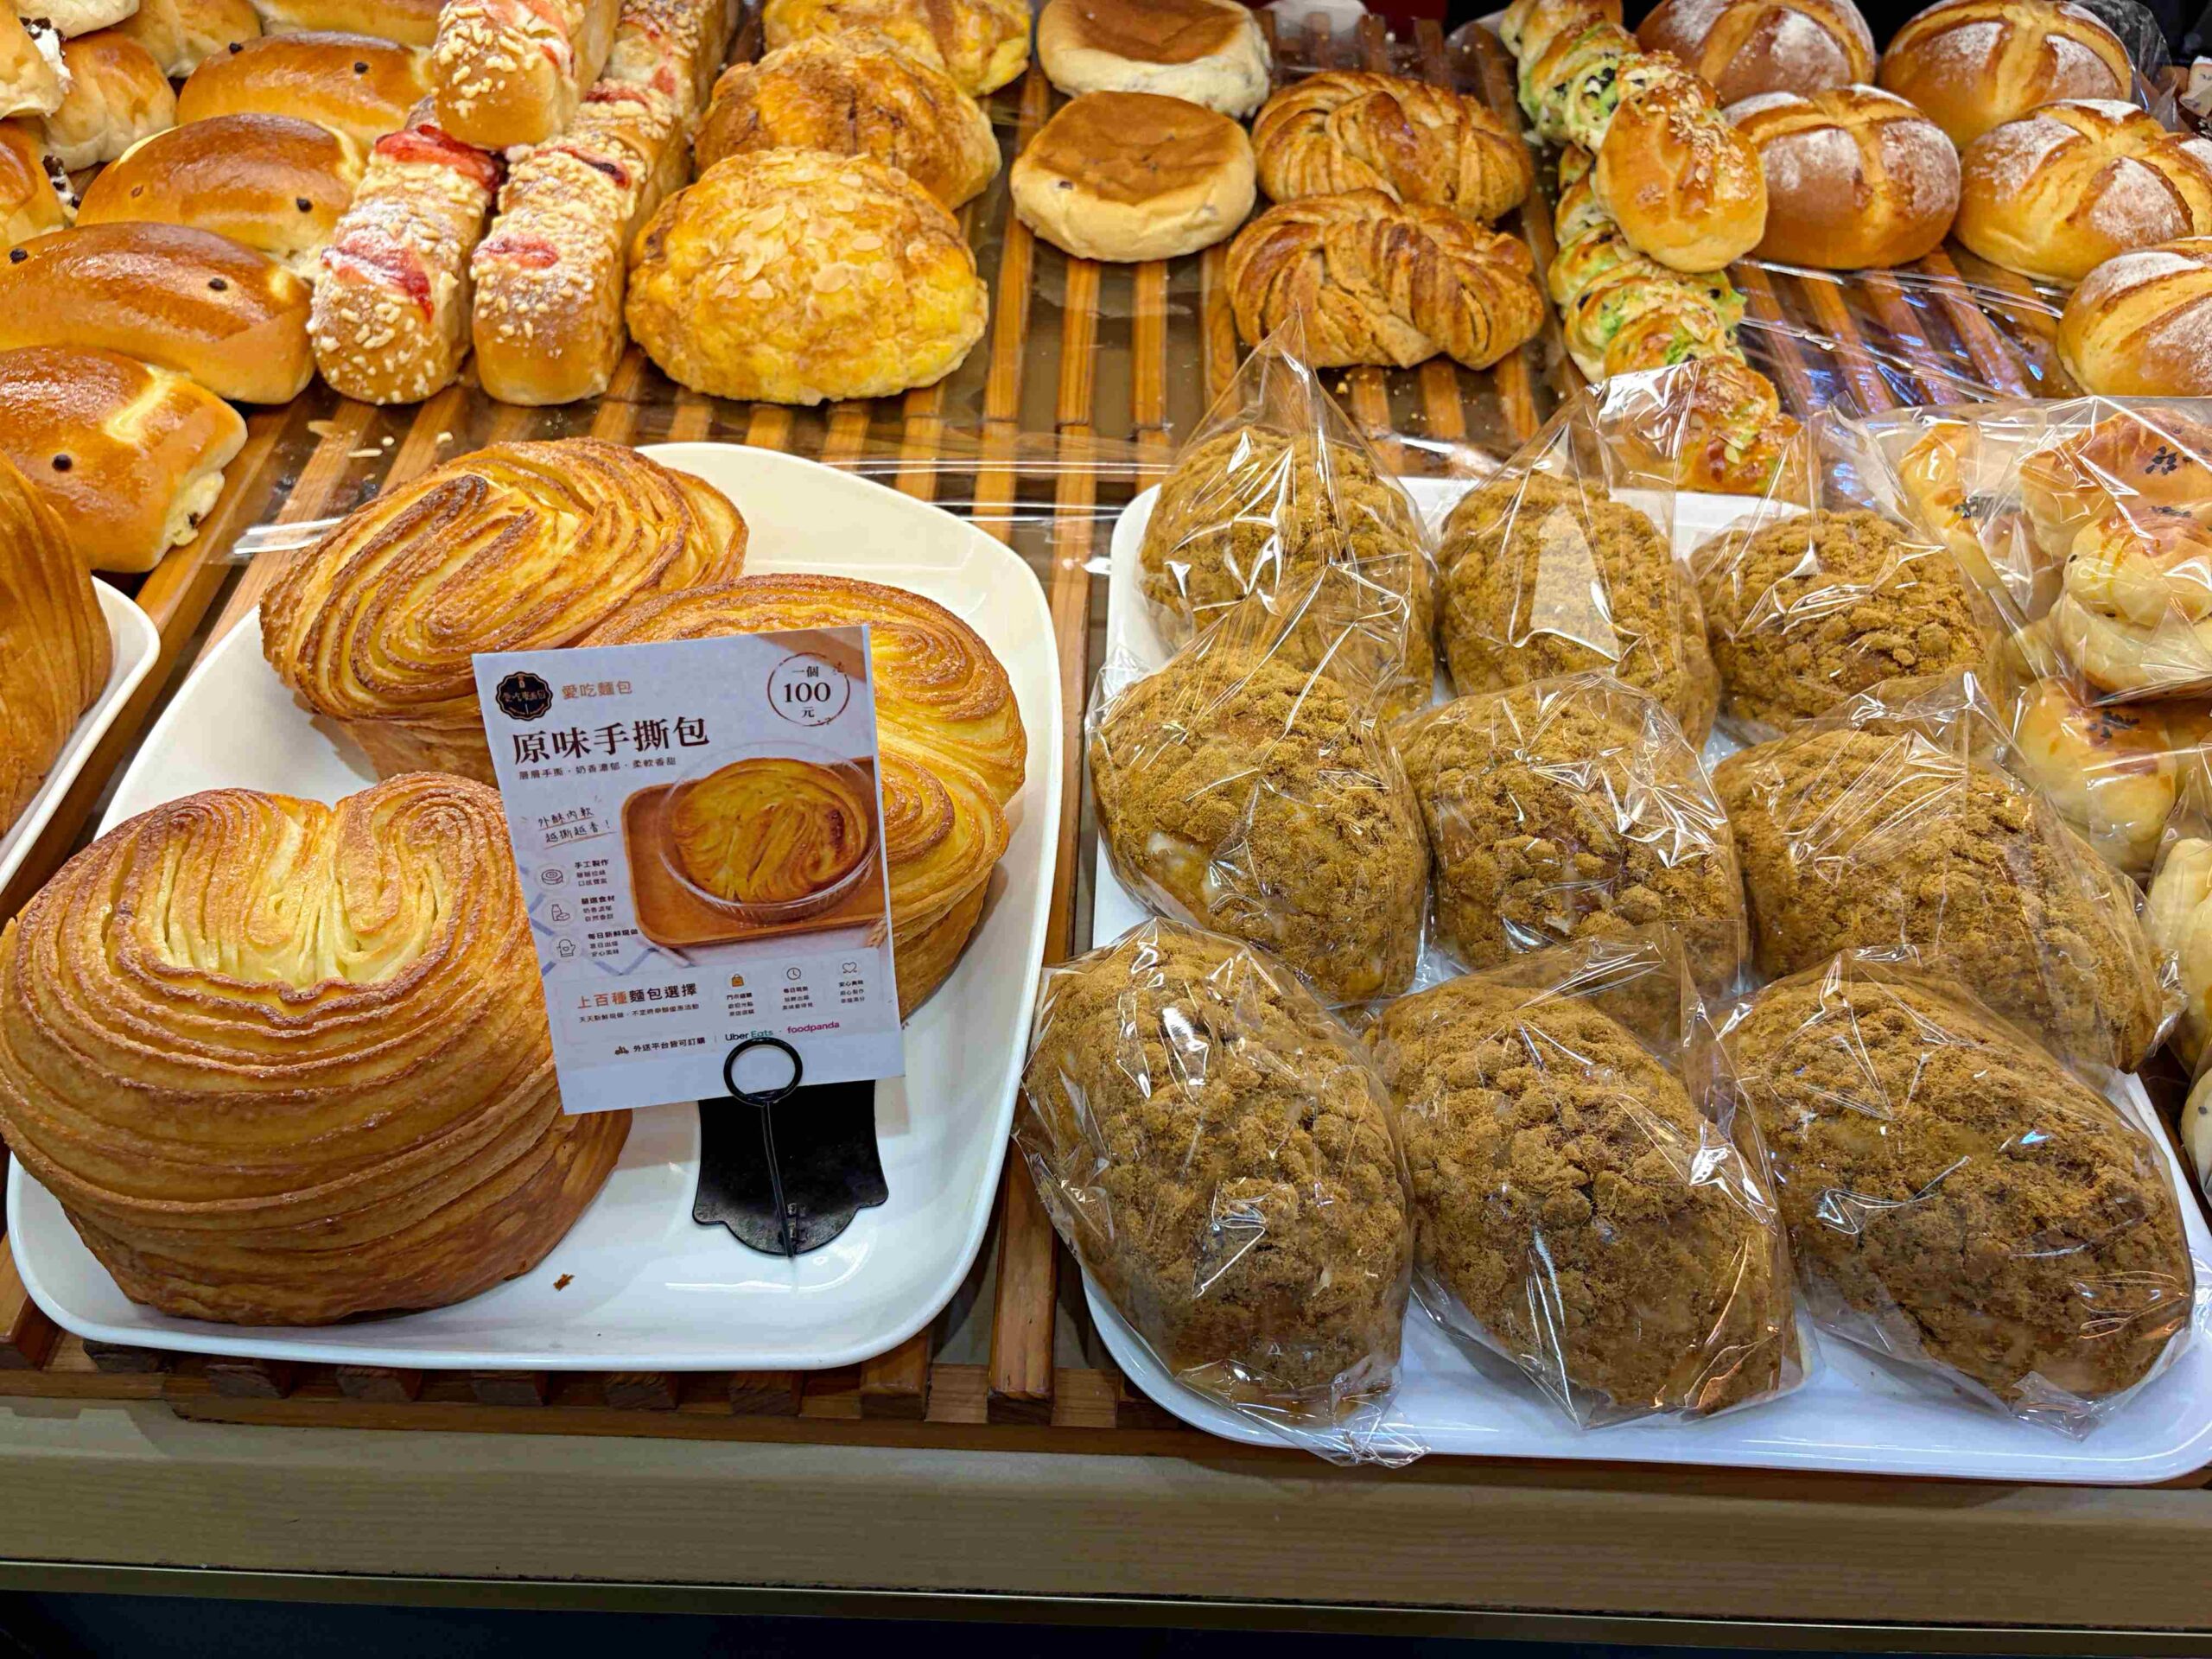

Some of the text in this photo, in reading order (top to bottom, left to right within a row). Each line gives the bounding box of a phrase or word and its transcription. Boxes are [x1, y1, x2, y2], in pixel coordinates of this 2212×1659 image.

[791, 665, 819, 678] 一個
[562, 679, 632, 701] 愛吃麵包
[784, 682, 831, 702] 100
[802, 707, 815, 718] 元
[512, 715, 710, 766] 原味手撕包
[577, 982, 698, 1009] 上百種麵包選擇
[725, 1029, 774, 1041] Uber Eats
[787, 1020, 840, 1034] foodpanda
